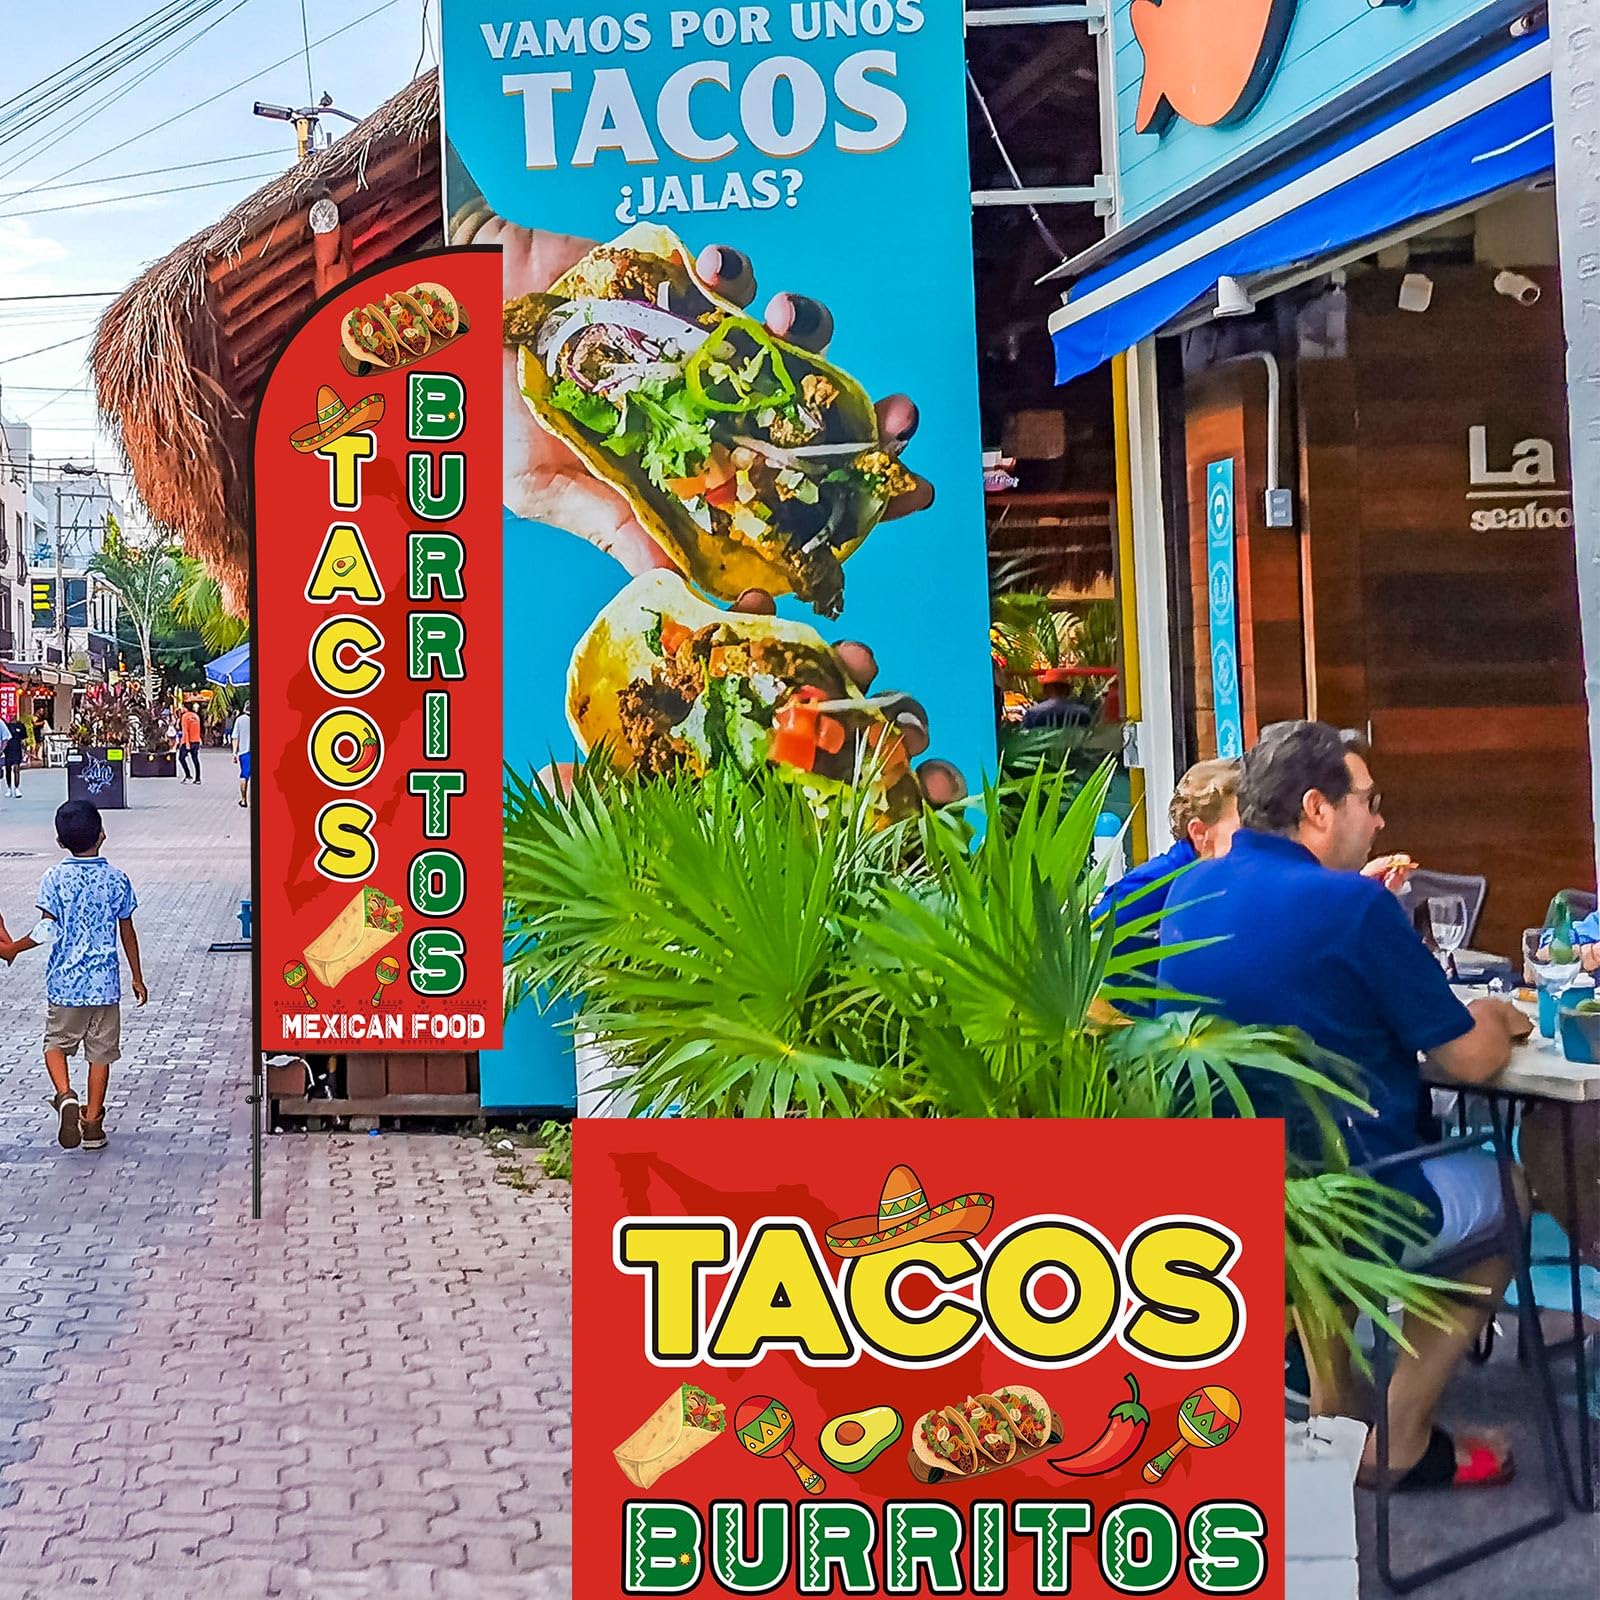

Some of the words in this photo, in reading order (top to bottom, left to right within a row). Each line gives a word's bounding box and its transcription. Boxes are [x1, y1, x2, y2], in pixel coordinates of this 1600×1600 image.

[480, 12, 652, 59] VAMOS
[670, 6, 771, 48] POR
[791, 0, 926, 41] UNOS
[502, 49, 908, 169] TACOS
[614, 168, 805, 224] ¿JALAS?
[1469, 425, 1556, 485] La
[303, 427, 386, 883] TACOS
[405, 370, 467, 999] BURRITOS
[282, 1014, 403, 1039] MEXICAN
[411, 1014, 486, 1039] FOOD
[613, 1214, 1248, 1370] TACOS
[620, 1498, 1269, 1596] BURRITOS
